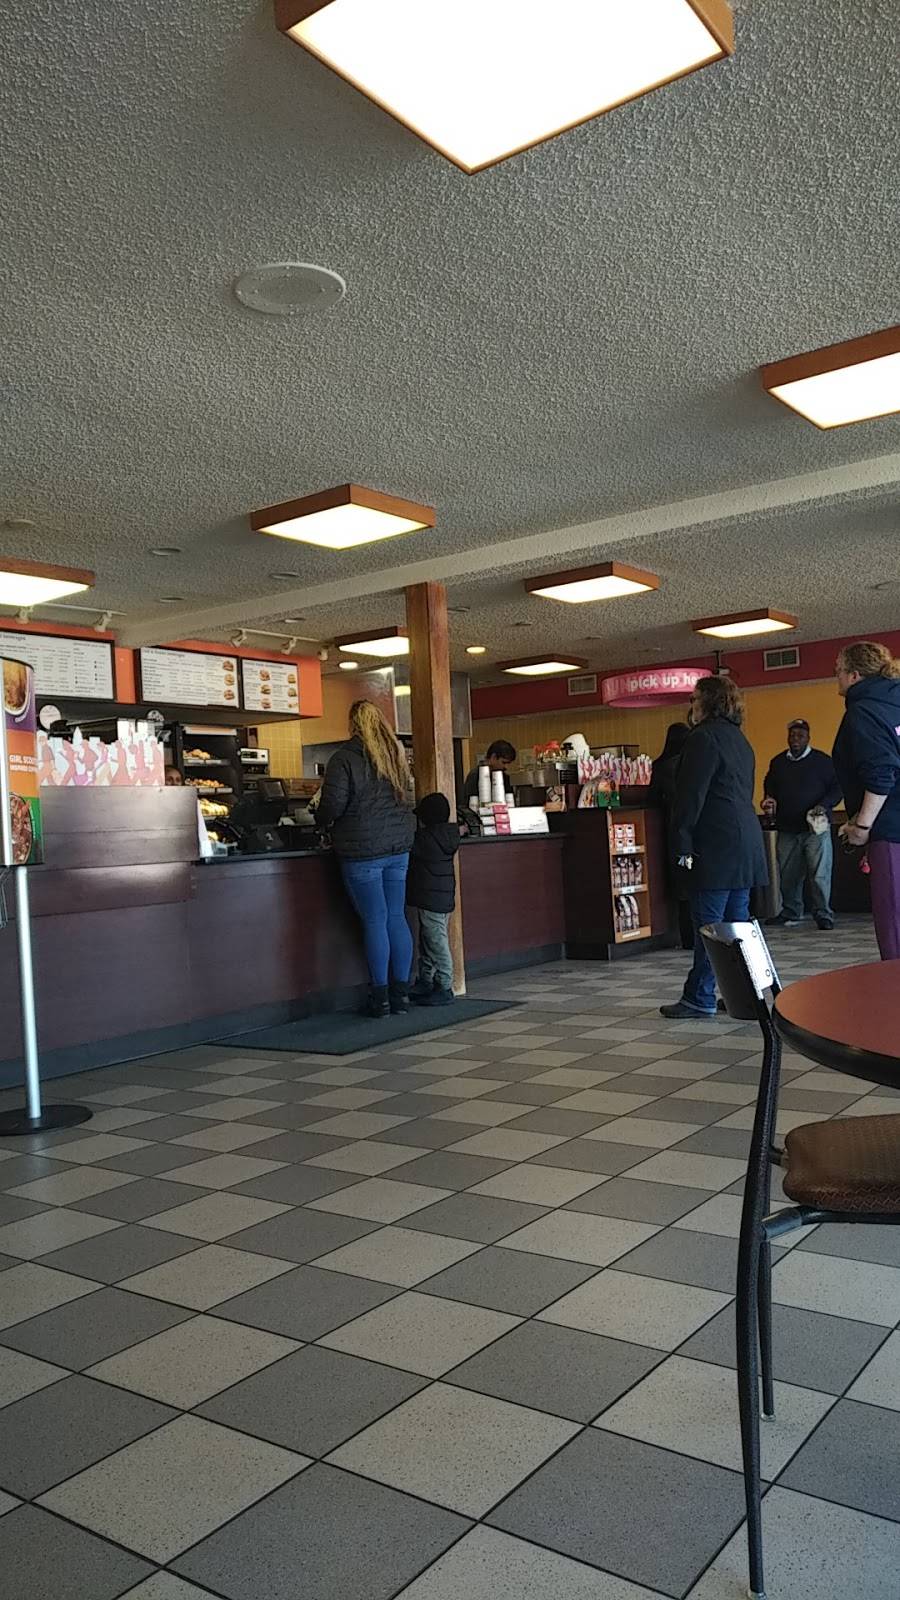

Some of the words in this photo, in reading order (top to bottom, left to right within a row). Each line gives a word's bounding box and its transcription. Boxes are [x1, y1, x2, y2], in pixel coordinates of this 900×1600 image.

[628, 674, 659, 693] pick
[662, 674, 680, 689] up
[683, 671, 699, 685] he
